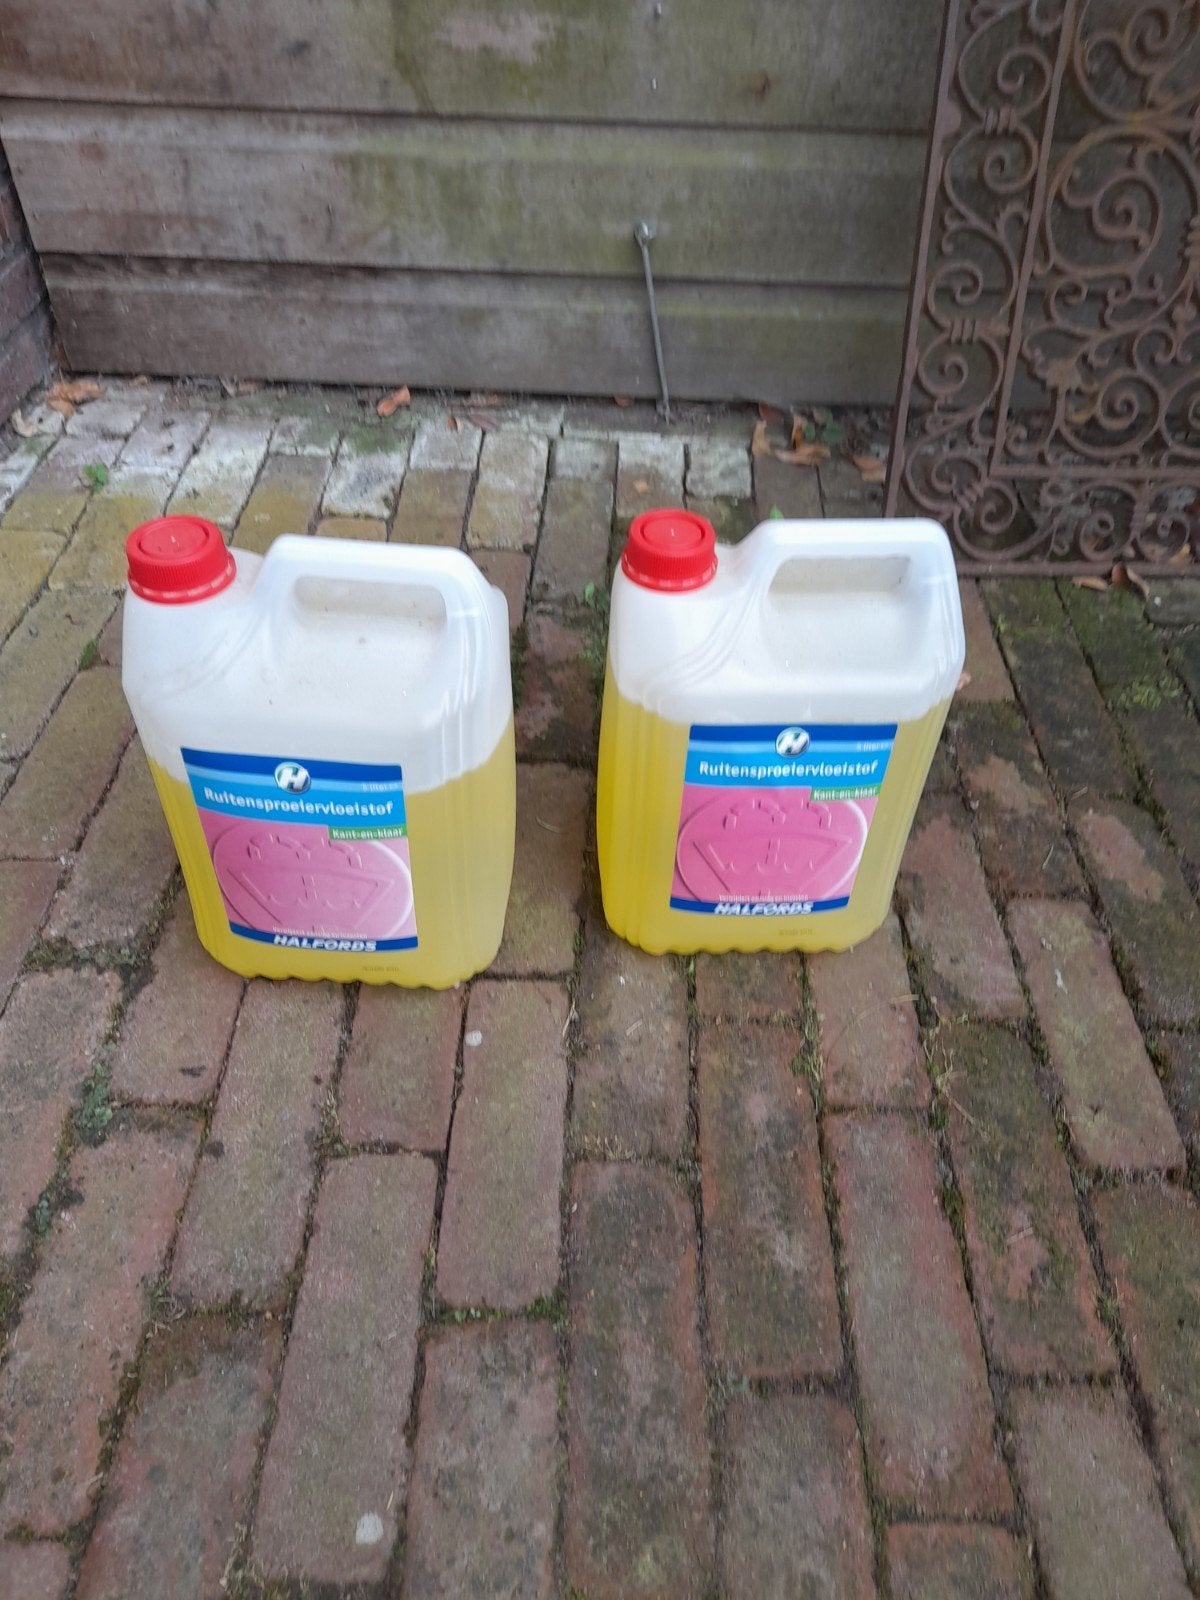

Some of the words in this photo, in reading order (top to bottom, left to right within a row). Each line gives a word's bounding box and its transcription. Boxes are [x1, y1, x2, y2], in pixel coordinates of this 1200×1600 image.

[278, 764, 307, 791] H
[699, 759, 878, 779] Ruitensproeiervloeistof
[204, 787, 394, 817] Ruitensproeiervloeistof
[332, 827, 403, 840] Kant-en-klaar
[714, 902, 814, 915] HALFORDS
[273, 934, 377, 952] HALFORDS
